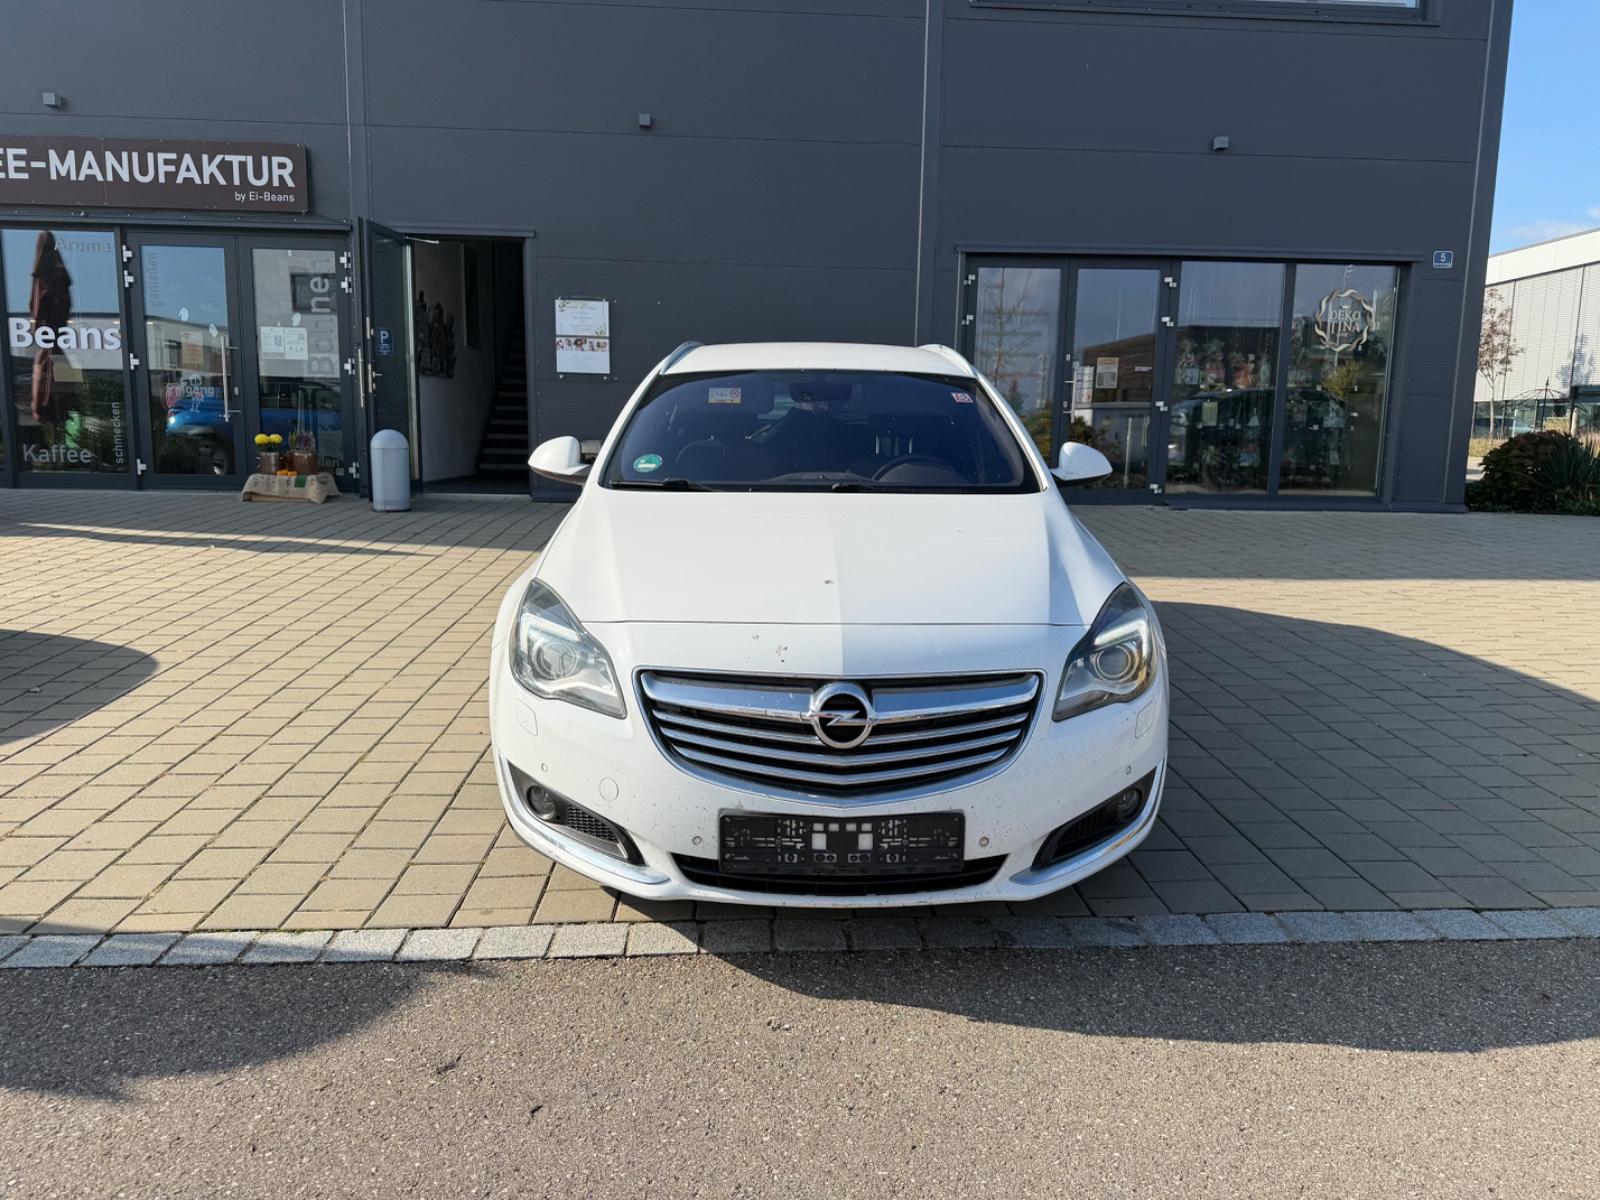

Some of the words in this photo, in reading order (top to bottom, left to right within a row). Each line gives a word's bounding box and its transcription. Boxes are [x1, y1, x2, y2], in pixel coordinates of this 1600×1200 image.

[0, 147, 295, 188] E-MANUFAKTUR
[234, 191, 246, 203] by
[249, 191, 295, 202] Ei-Beans
[1440, 252, 1446, 262] 5
[1330, 310, 1361, 321] DEKO
[9, 317, 121, 350] Beans
[380, 330, 390, 344] P
[111, 401, 124, 464] schmecken
[22, 443, 92, 463] Kaffee
